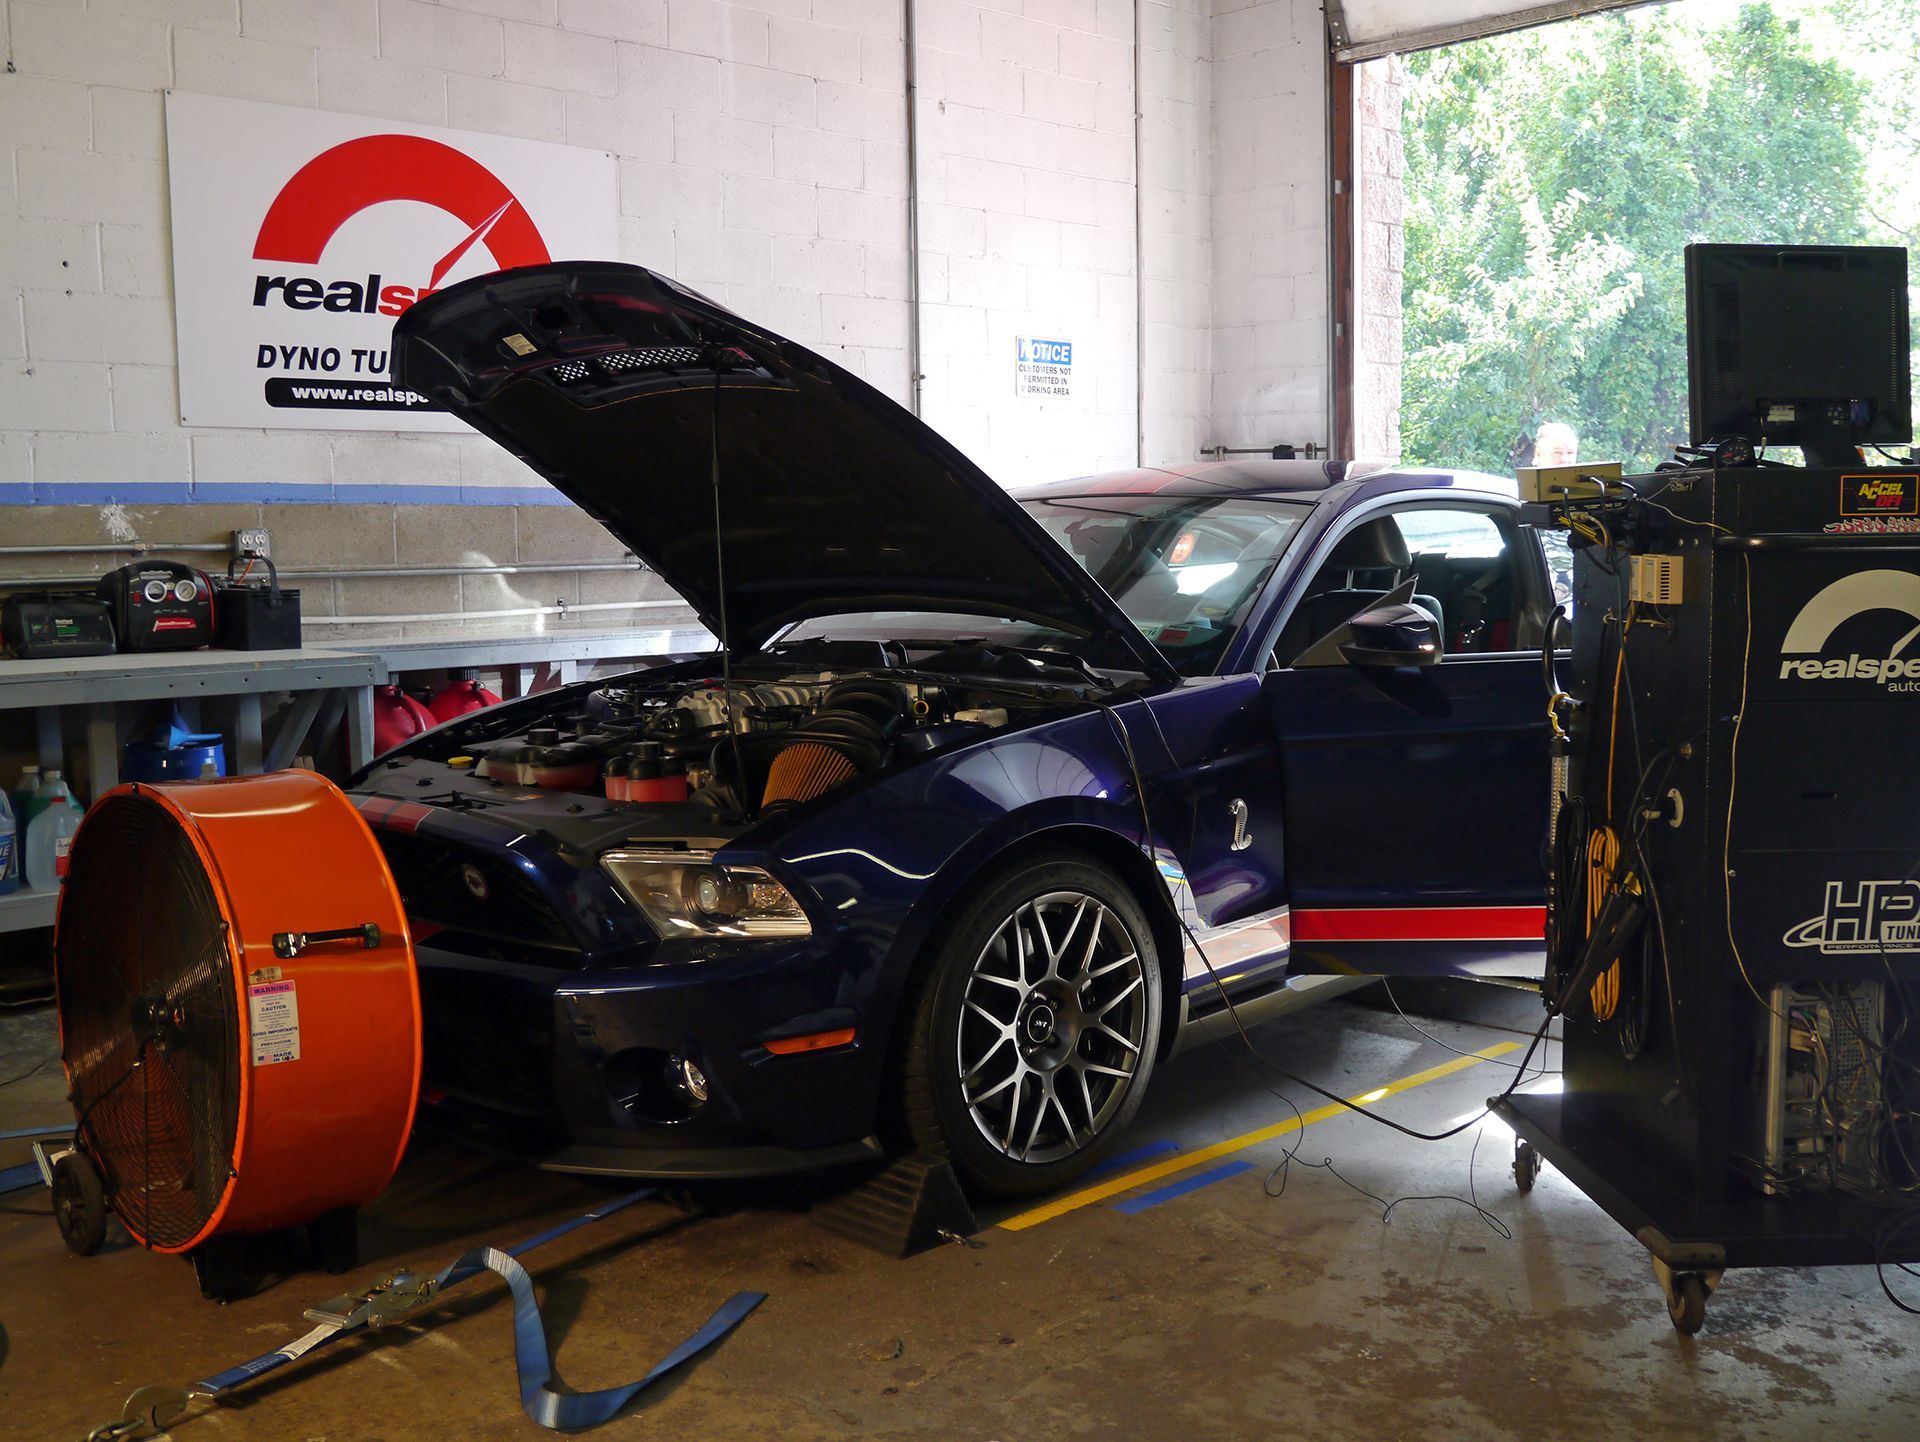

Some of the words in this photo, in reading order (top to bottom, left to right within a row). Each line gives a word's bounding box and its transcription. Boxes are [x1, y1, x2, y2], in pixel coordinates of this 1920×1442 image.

[1020, 338, 1070, 362] NOTICE
[257, 344, 341, 371] DYNO
[351, 349, 392, 375] TU
[1060, 367, 1072, 376] NOT
[1023, 375, 1060, 385] PERMITTED
[1060, 377, 1068, 385] IN
[1052, 387, 1070, 396] AREA
[1858, 480, 1904, 499] ACCEL
[254, 984, 289, 994] WARNING
[261, 1004, 287, 1012] CAUTION
